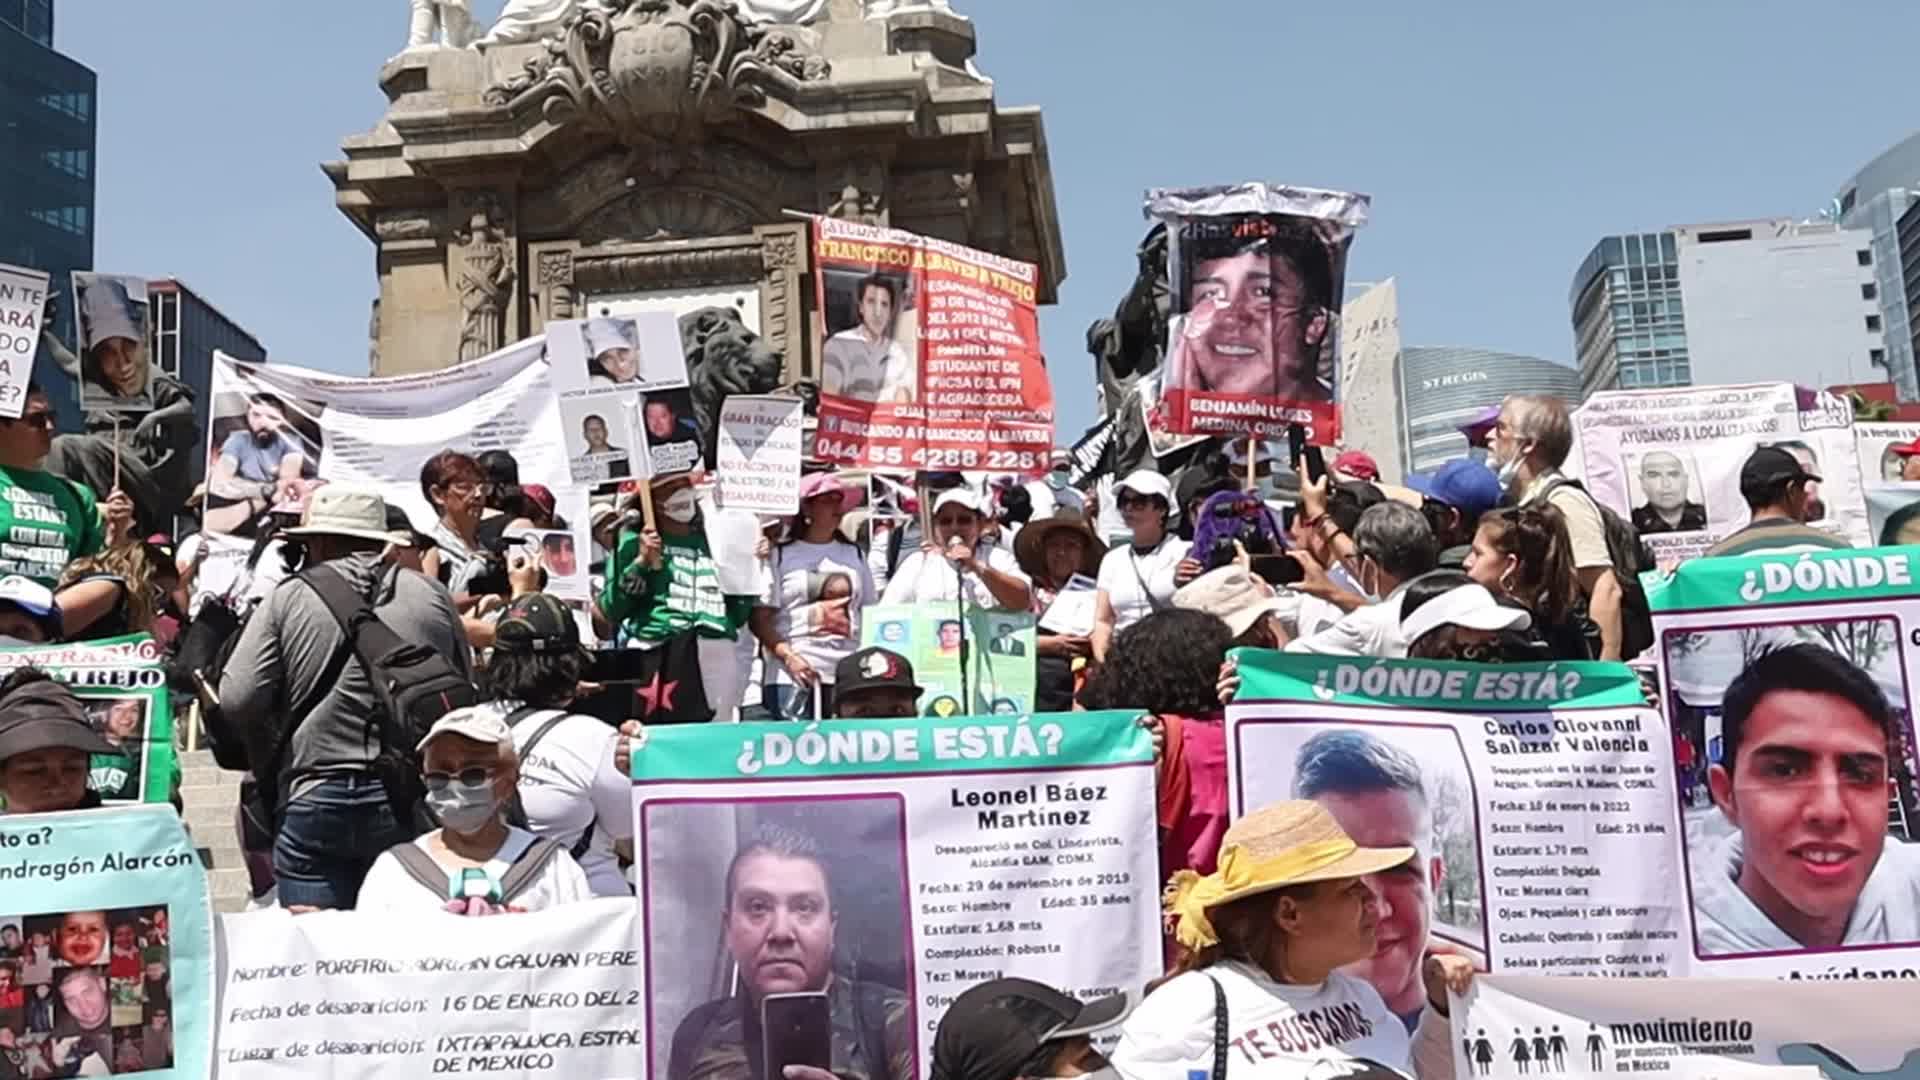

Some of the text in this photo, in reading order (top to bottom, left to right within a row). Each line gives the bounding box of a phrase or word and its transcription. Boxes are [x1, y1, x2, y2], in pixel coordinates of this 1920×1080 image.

[818, 240, 910, 267] FRANCISCO
[991, 271, 1036, 302] TREJO
[1190, 397, 1267, 416] BENJAMÍN
[867, 445, 903, 465] 55
[911, 449, 977, 468] 4288
[986, 450, 1050, 470] 2281
[1740, 552, 1911, 602] ¿DÓNDE
[1312, 660, 1582, 701] ¿DÓNDE ESTÁ?
[1483, 719, 1551, 737] Carlos
[736, 715, 1064, 775] ¿DÓNDE ESTÁ?
[1484, 737, 1650, 755] Salazar Valencia
[951, 781, 1108, 808] Leonel Báez
[1490, 800, 1527, 813] Fecha:
[978, 806, 1092, 830] Martínez
[26, 826, 53, 847] a?
[1013, 842, 1028, 850] en
[100, 849, 193, 873] Alarcón
[919, 882, 963, 894] Fecha:
[967, 880, 984, 892] 29
[988, 879, 1003, 890] de
[1006, 877, 1072, 889] noviembre
[1077, 875, 1093, 885] de
[921, 903, 957, 915] Sexo:
[961, 901, 1011, 913] Hombre
[1041, 896, 1076, 910] Edad:
[924, 924, 982, 936] Estatura:
[925, 944, 1061, 961] Complexión: Robusta
[232, 963, 306, 983] Nombre:
[583, 950, 638, 967] PERE
[925, 971, 951, 983] Tez:
[230, 989, 640, 1023] Fecha de desaparición: 16 DE ENERO DEL 2
[1230, 999, 1374, 1065] TE BUSCAMOS
[1609, 1018, 1753, 1044] movimiento
[284, 1042, 309, 1058] de
[436, 1031, 575, 1054] IXTAPALUCA,
[432, 1056, 464, 1073] DE
